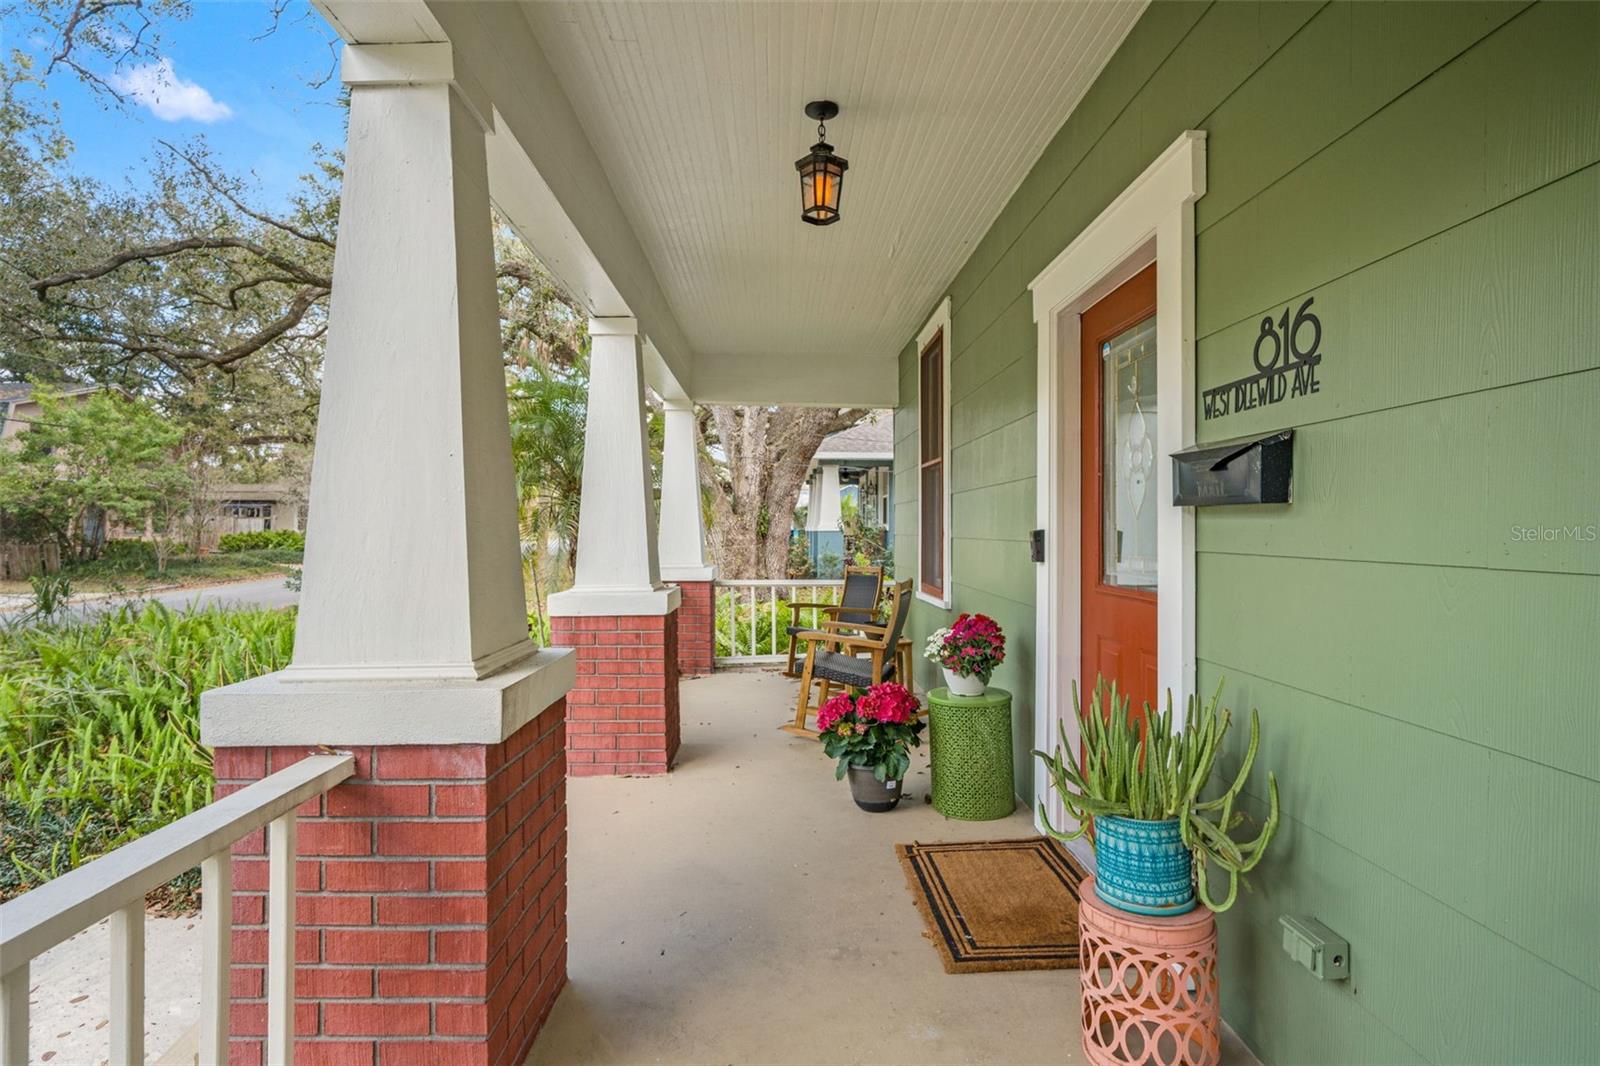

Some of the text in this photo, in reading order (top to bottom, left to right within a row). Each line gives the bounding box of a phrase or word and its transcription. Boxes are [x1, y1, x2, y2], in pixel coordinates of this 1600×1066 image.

[1253, 296, 1322, 374] 816
[1203, 361, 1321, 420] WEST IDLEWILD AVE
